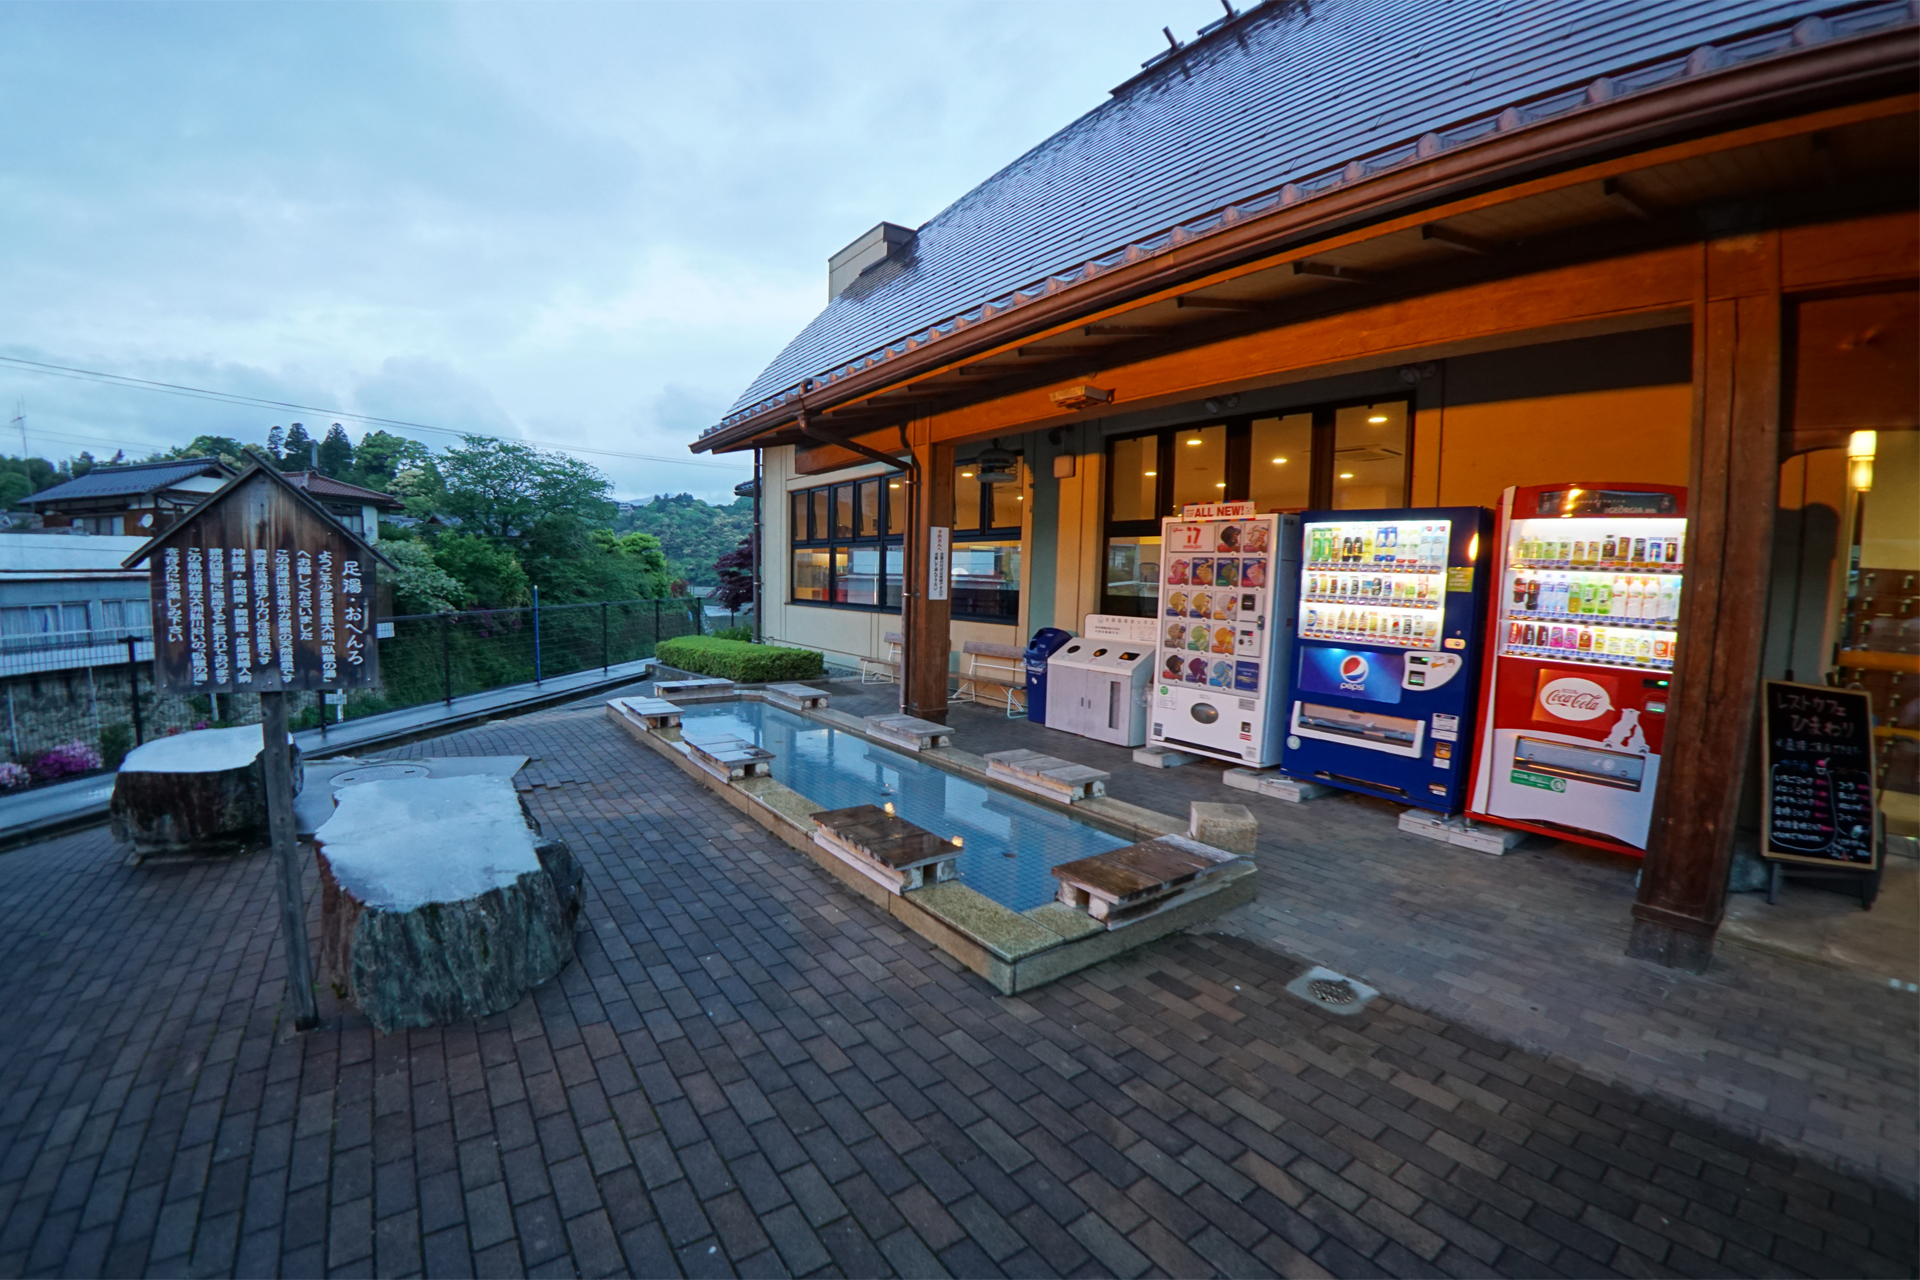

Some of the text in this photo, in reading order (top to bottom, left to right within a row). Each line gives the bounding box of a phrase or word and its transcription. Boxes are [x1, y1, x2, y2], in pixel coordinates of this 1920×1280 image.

[1194, 506, 1214, 518] ALL
[1216, 505, 1245, 517] NEW!
[297, 550, 313, 641] へお越しくださいました
[342, 561, 364, 665] 足湯・おへんろ
[1339, 682, 1365, 691] pepsi
[1546, 689, 1604, 710] Coca-Cola
[1776, 692, 1847, 717] レストカフェ
[1790, 714, 1854, 738] ひまわり
